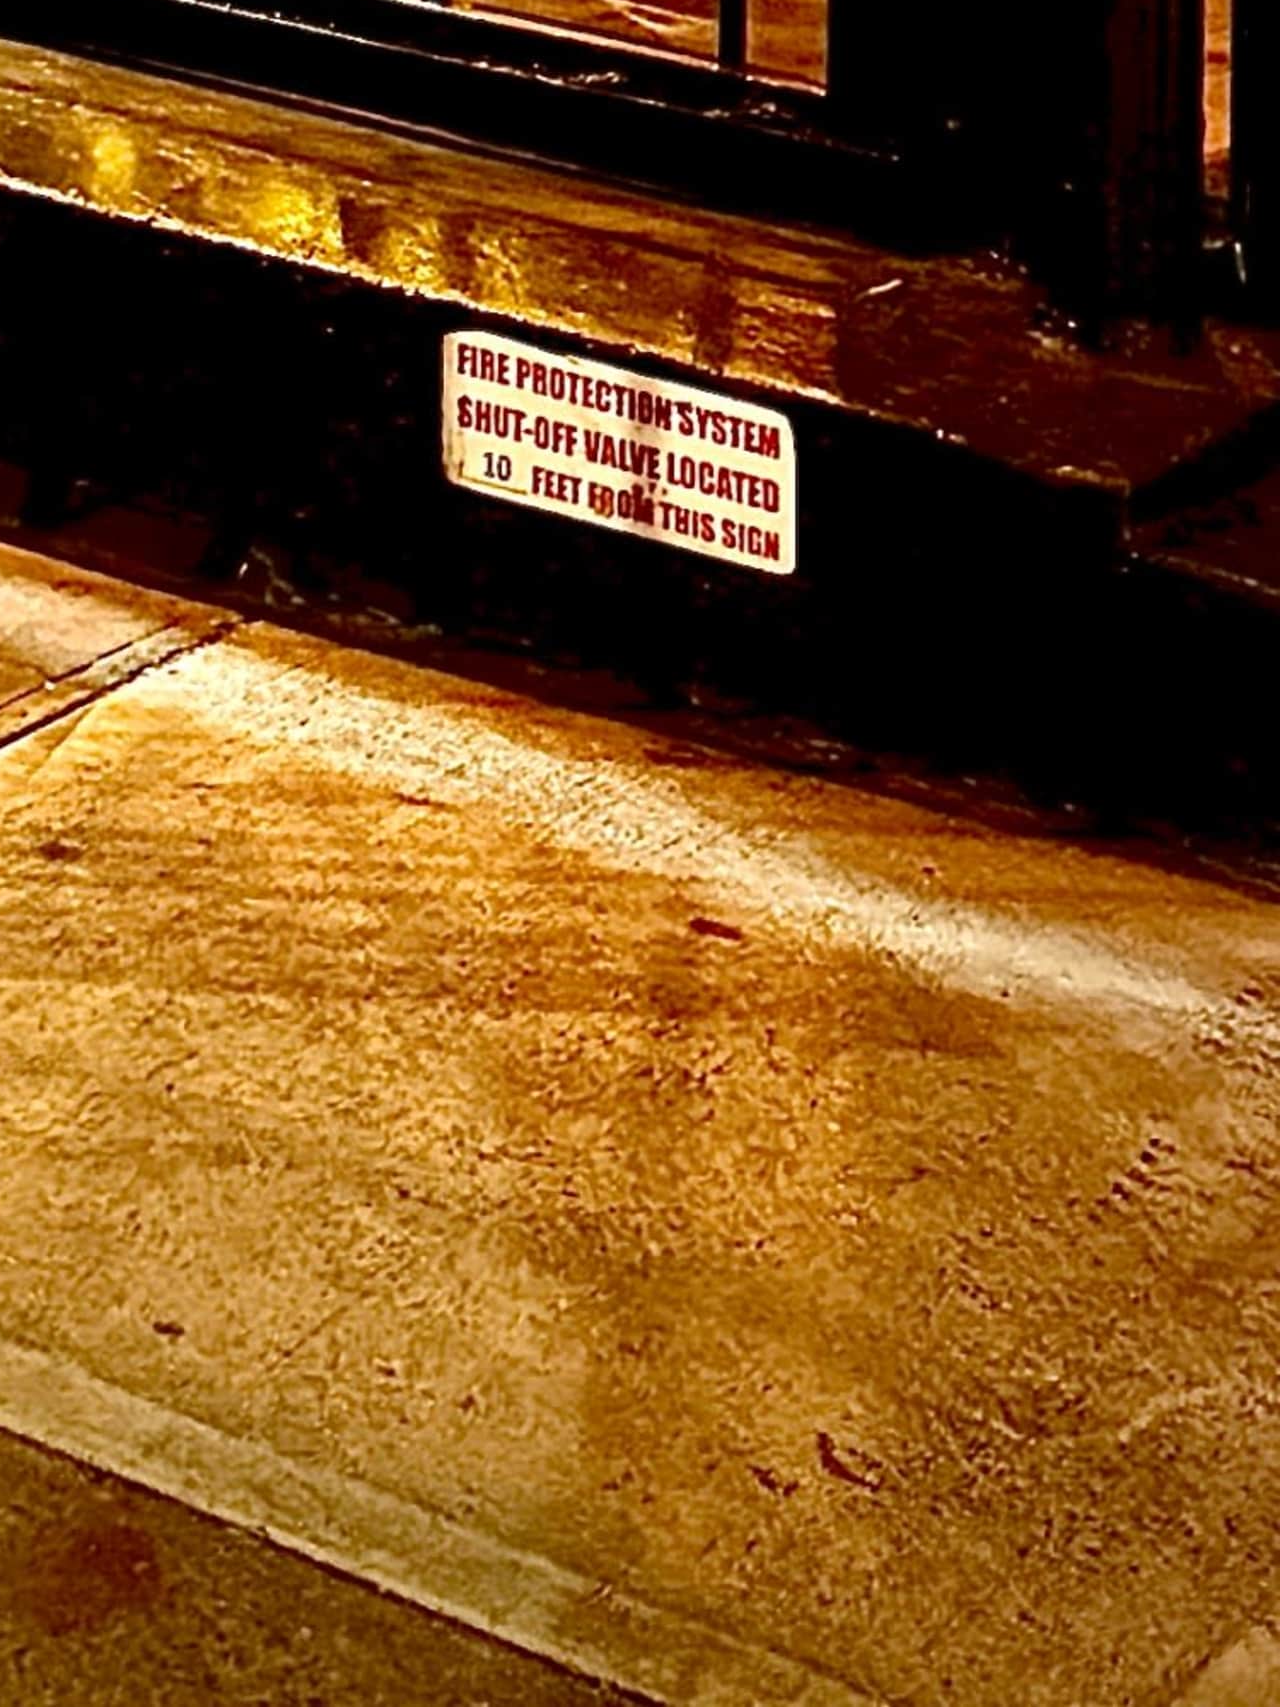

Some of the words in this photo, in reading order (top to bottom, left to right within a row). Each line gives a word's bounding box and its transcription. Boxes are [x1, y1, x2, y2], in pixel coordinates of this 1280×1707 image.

[457, 342, 510, 386] FIRE
[515, 357, 672, 431] PROTECTION
[674, 401, 781, 460] SYSTEM
[457, 394, 578, 457] SHUT-OFF
[583, 429, 661, 481] VALVE
[667, 452, 780, 513] LOCATED
[482, 451, 513, 482] 10
[531, 465, 583, 505] FEET
[587, 481, 656, 527] FROM
[657, 500, 716, 543] THIS
[721, 517, 781, 562] SIGN
